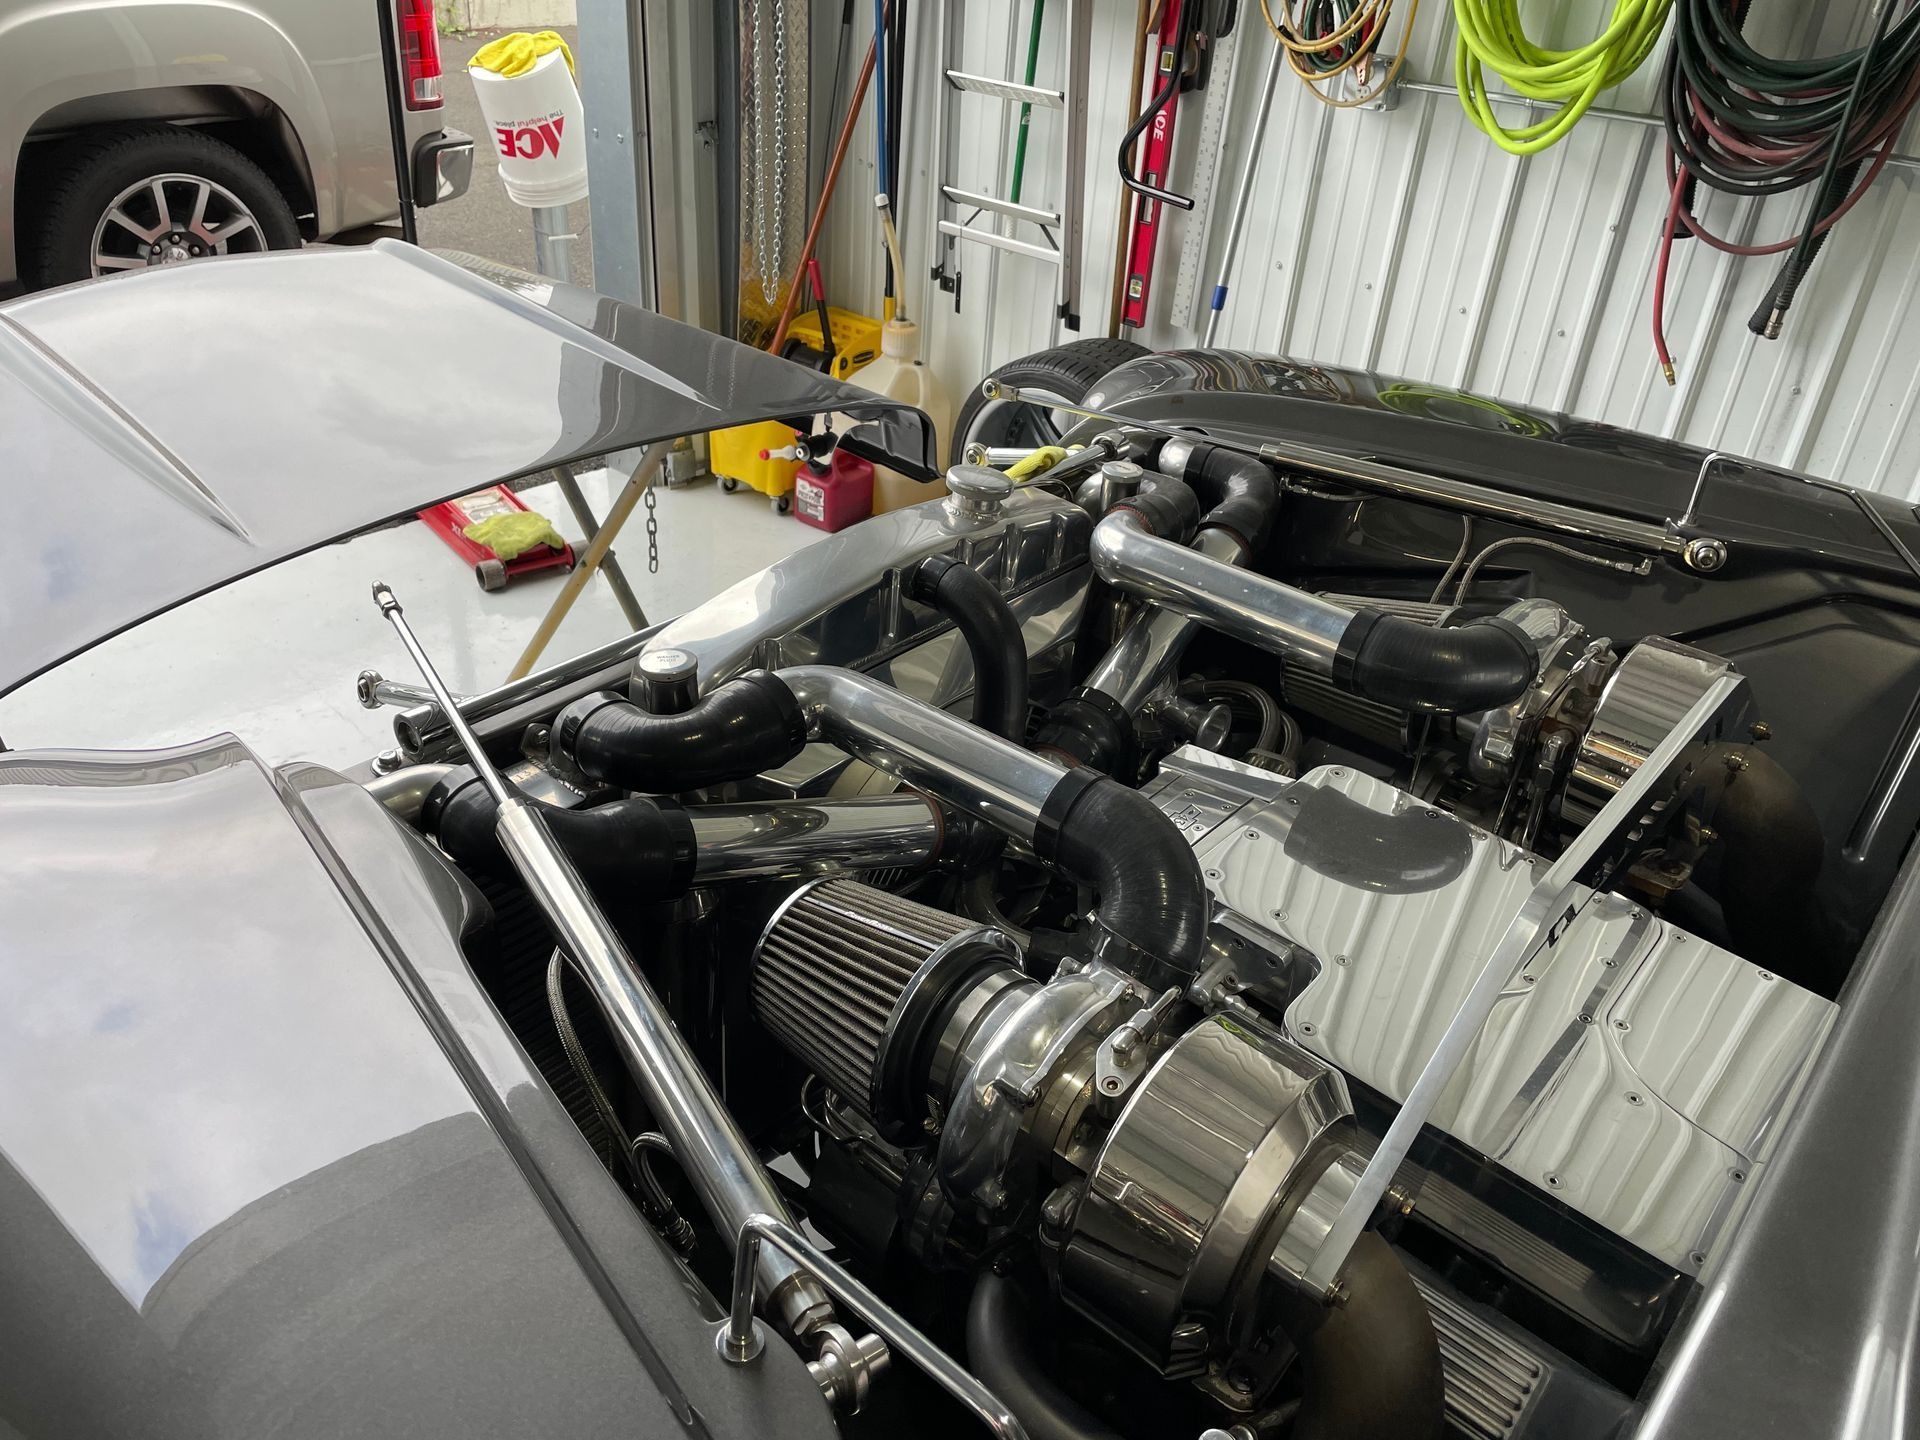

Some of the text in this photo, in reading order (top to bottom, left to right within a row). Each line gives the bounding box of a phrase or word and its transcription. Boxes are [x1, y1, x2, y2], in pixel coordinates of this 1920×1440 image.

[549, 109, 564, 119] The
[517, 115, 548, 128] helpful
[496, 116, 565, 160] ACE
